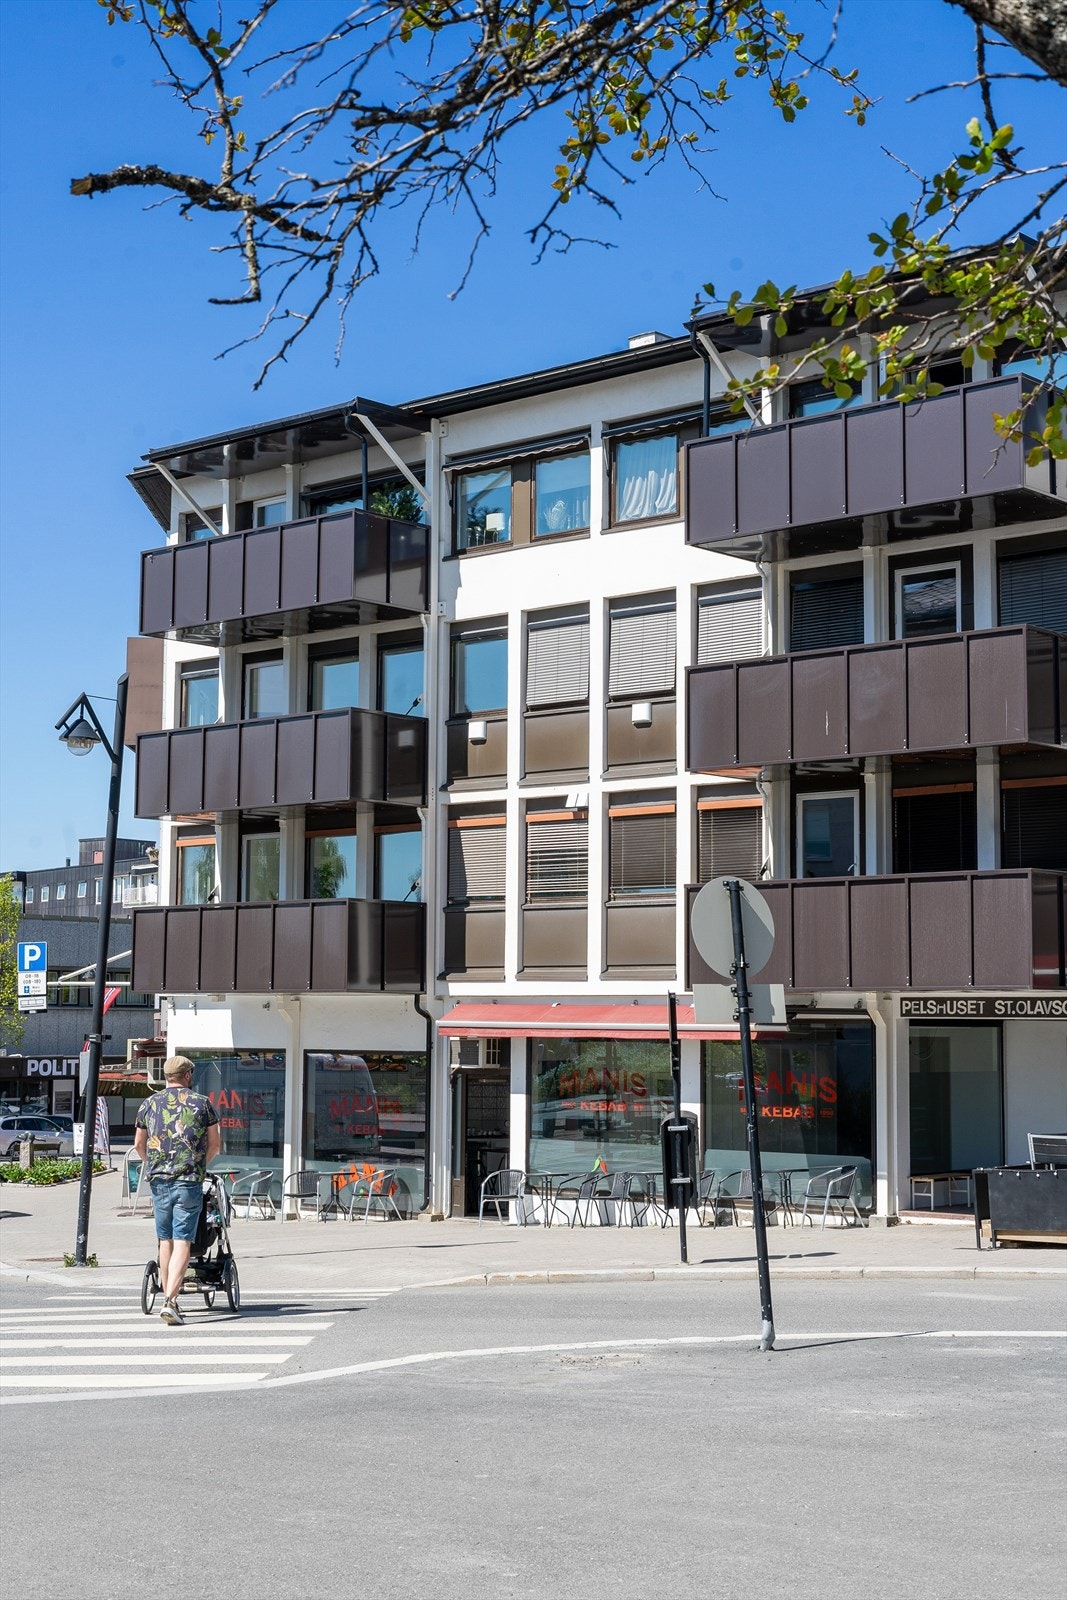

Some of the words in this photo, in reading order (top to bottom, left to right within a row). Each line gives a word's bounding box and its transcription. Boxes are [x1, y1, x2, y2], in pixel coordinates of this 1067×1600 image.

[24, 944, 41, 970] P
[902, 1000, 986, 1015] PELSHUSET
[560, 1067, 647, 1097] MANIS
[580, 1101, 627, 1111] KEBAB
[762, 1106, 815, 1118] KEBAB
[220, 1117, 250, 1128] EBAB
